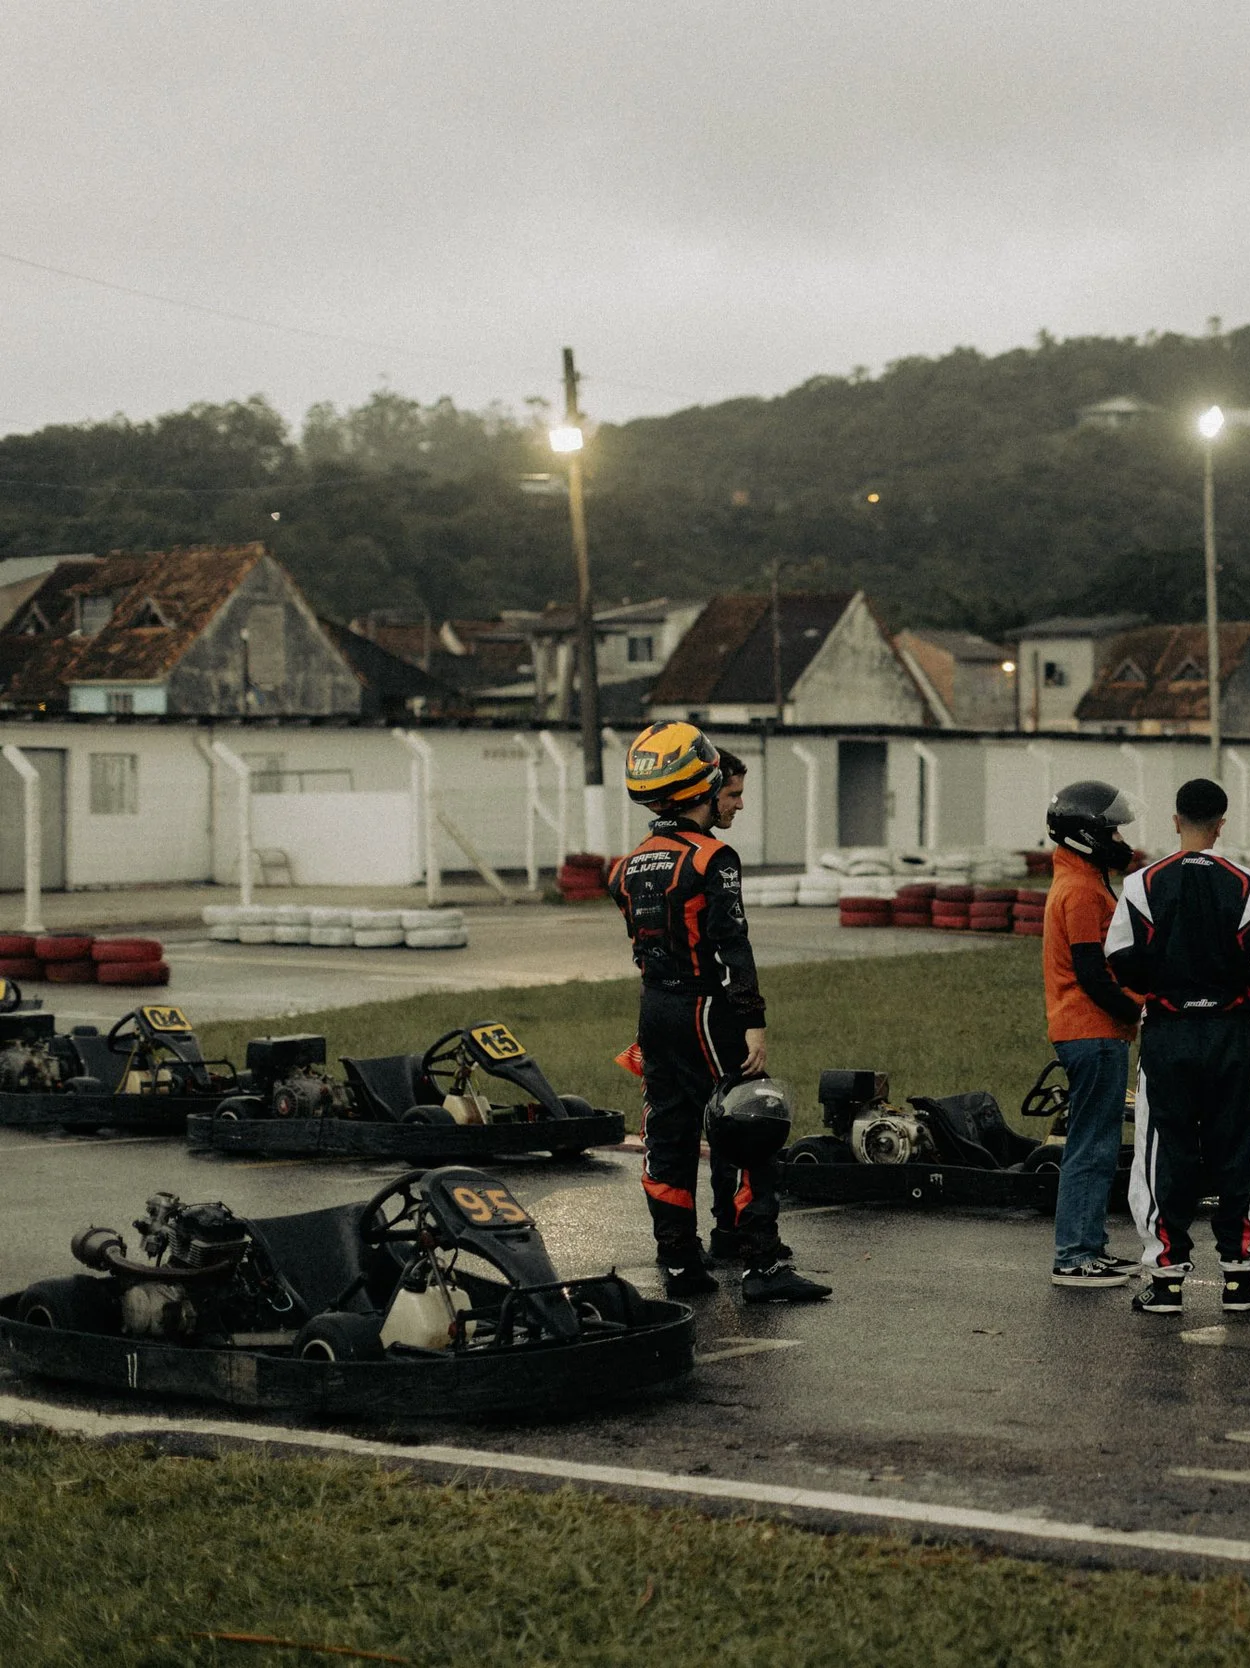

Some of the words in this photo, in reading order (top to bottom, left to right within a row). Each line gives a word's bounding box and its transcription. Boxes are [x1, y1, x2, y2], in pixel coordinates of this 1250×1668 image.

[625, 861, 675, 876] OLIVEIRA
[630, 851, 672, 865] RAFAEL
[481, 1028, 519, 1056] 15
[453, 1187, 526, 1222] 95
